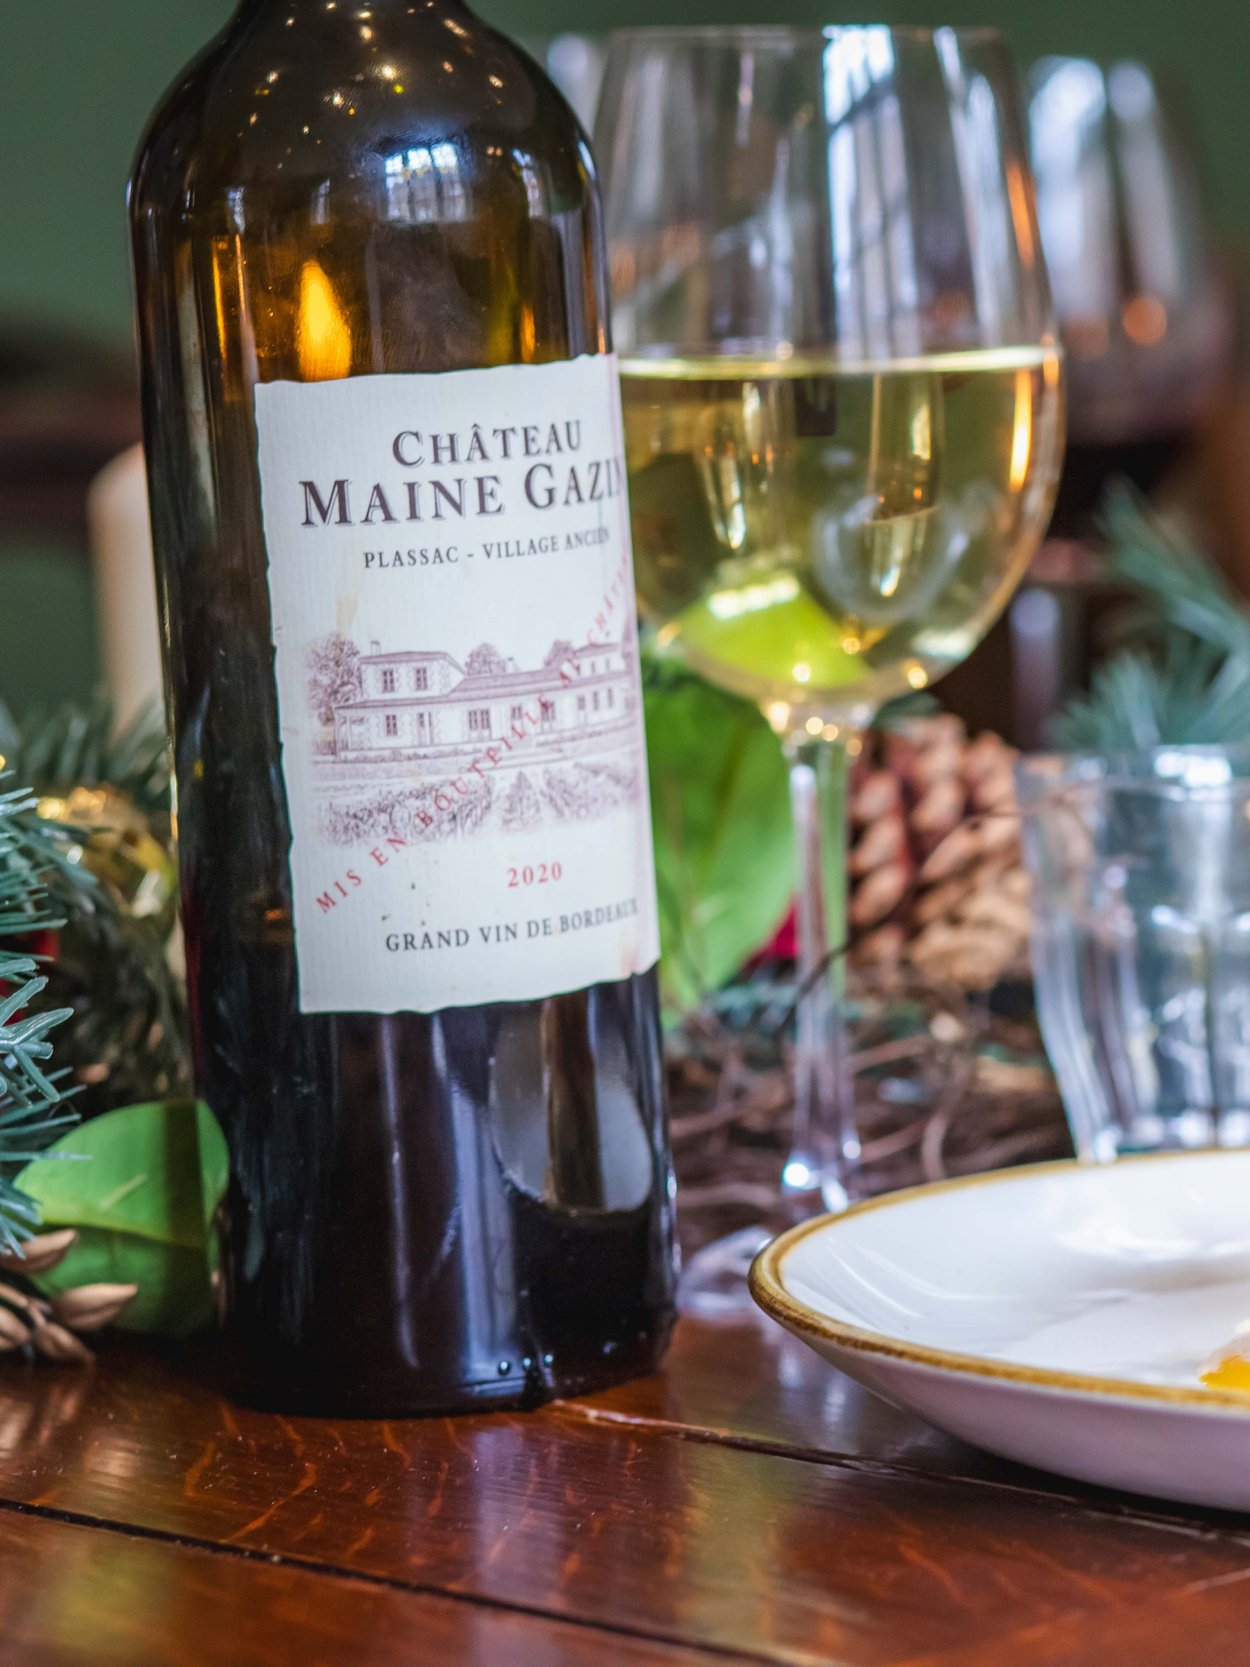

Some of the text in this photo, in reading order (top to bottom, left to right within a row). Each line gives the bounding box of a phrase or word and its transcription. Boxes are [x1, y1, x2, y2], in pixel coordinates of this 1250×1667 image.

[391, 419, 582, 469] CHÂTEAU
[298, 475, 504, 528] MAINE
[363, 546, 460, 569] PLASSAC
[482, 535, 560, 560] VILLAGE
[315, 868, 362, 914] MIS
[369, 830, 407, 868] EN
[415, 693, 556, 828] BOUTEILLE
[507, 861, 563, 888] 2020
[385, 897, 639, 952] GRAND VIN DE BORDEAUX
